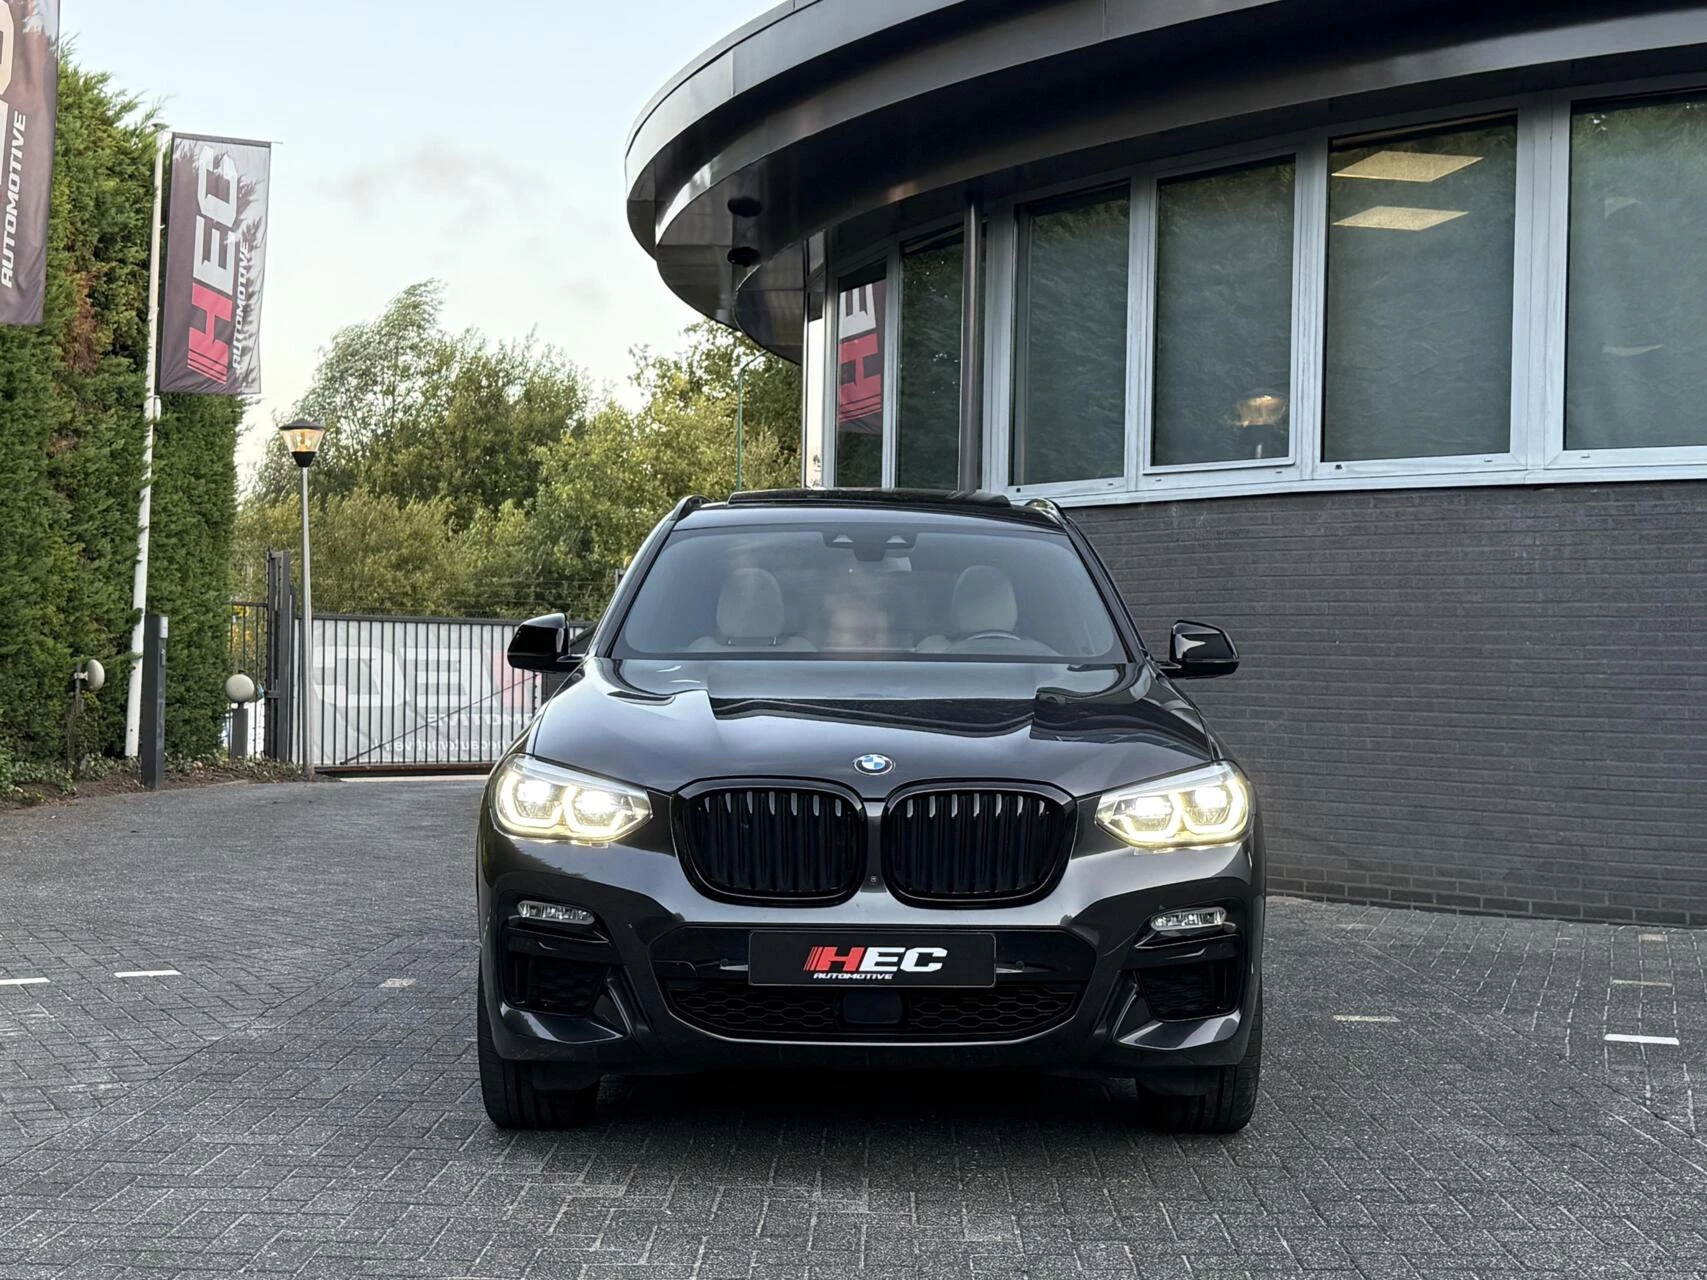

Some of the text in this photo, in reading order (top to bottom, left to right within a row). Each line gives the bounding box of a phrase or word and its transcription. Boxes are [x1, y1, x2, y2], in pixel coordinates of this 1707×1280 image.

[1, 111, 26, 289] AUTOMOTIVE
[187, 146, 238, 384] HEC
[232, 238, 249, 369] AUTOMOTIVE
[803, 946, 948, 972] HEC
[813, 972, 893, 980] AUTOMOTIVE
